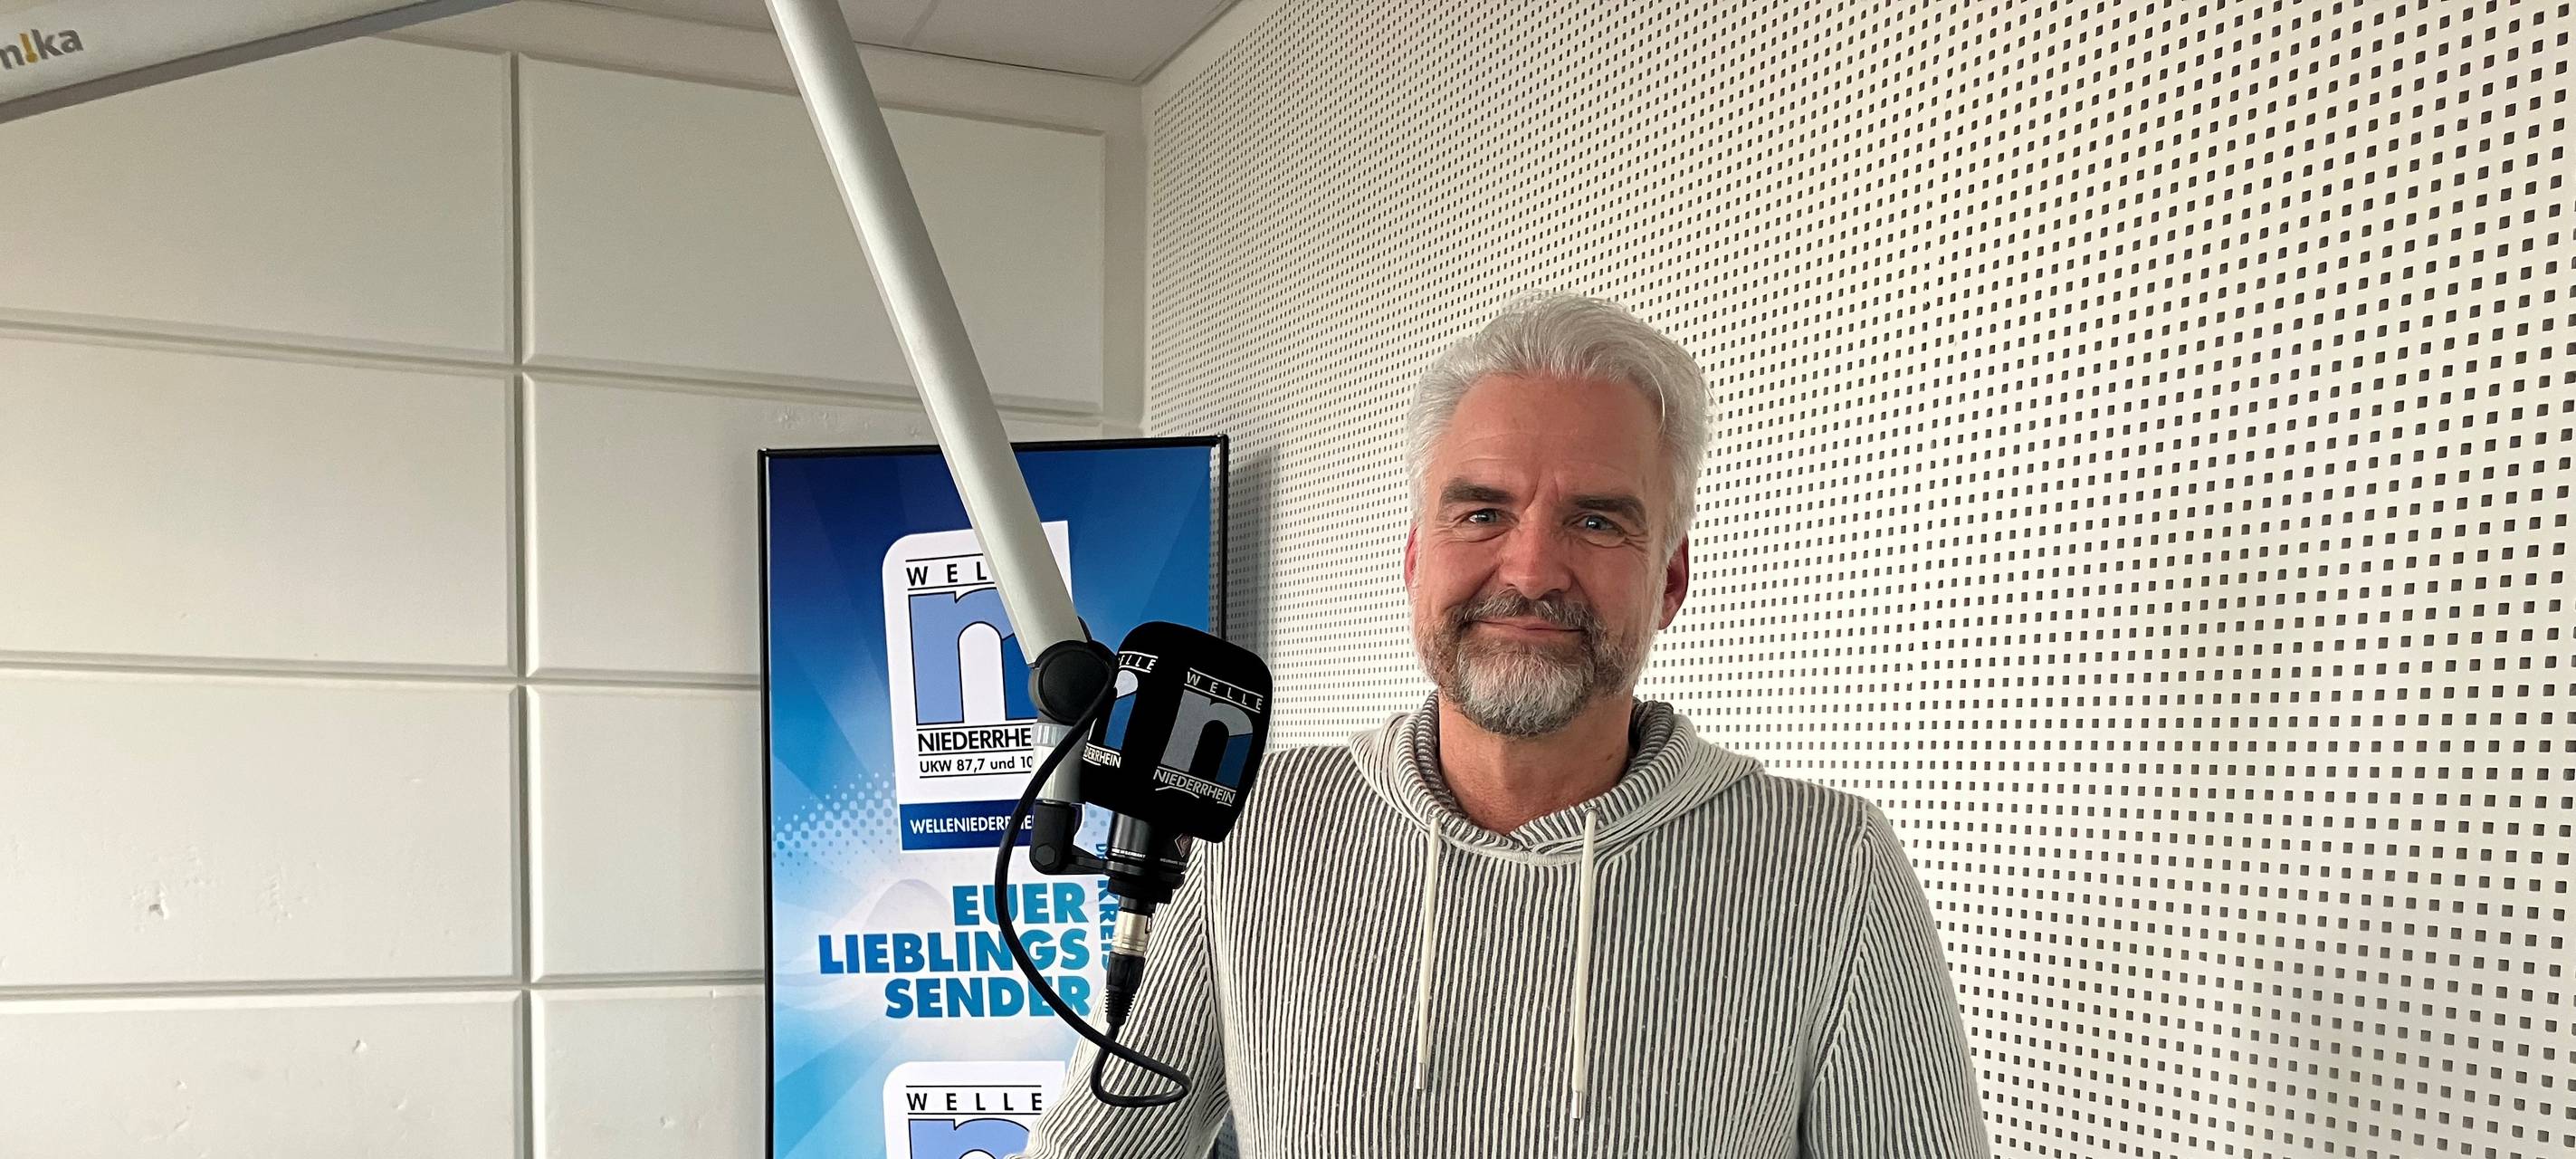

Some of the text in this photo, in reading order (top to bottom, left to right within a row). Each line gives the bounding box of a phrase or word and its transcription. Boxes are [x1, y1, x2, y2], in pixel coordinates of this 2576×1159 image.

[906, 561, 987, 586] WEL
[1119, 655, 1156, 670] ELLE
[1187, 671, 1263, 711] WELLE
[918, 727, 1032, 752] NIEDERRHE
[920, 755, 1033, 773] UKW 87,7 und 10
[1152, 769, 1236, 805] NIEDERRHEIN
[952, 882, 1090, 925] EUER
[818, 928, 1091, 974] LIEBLINGS
[884, 975, 1092, 1019] SENDER
[906, 1092, 1043, 1111] WELLE
